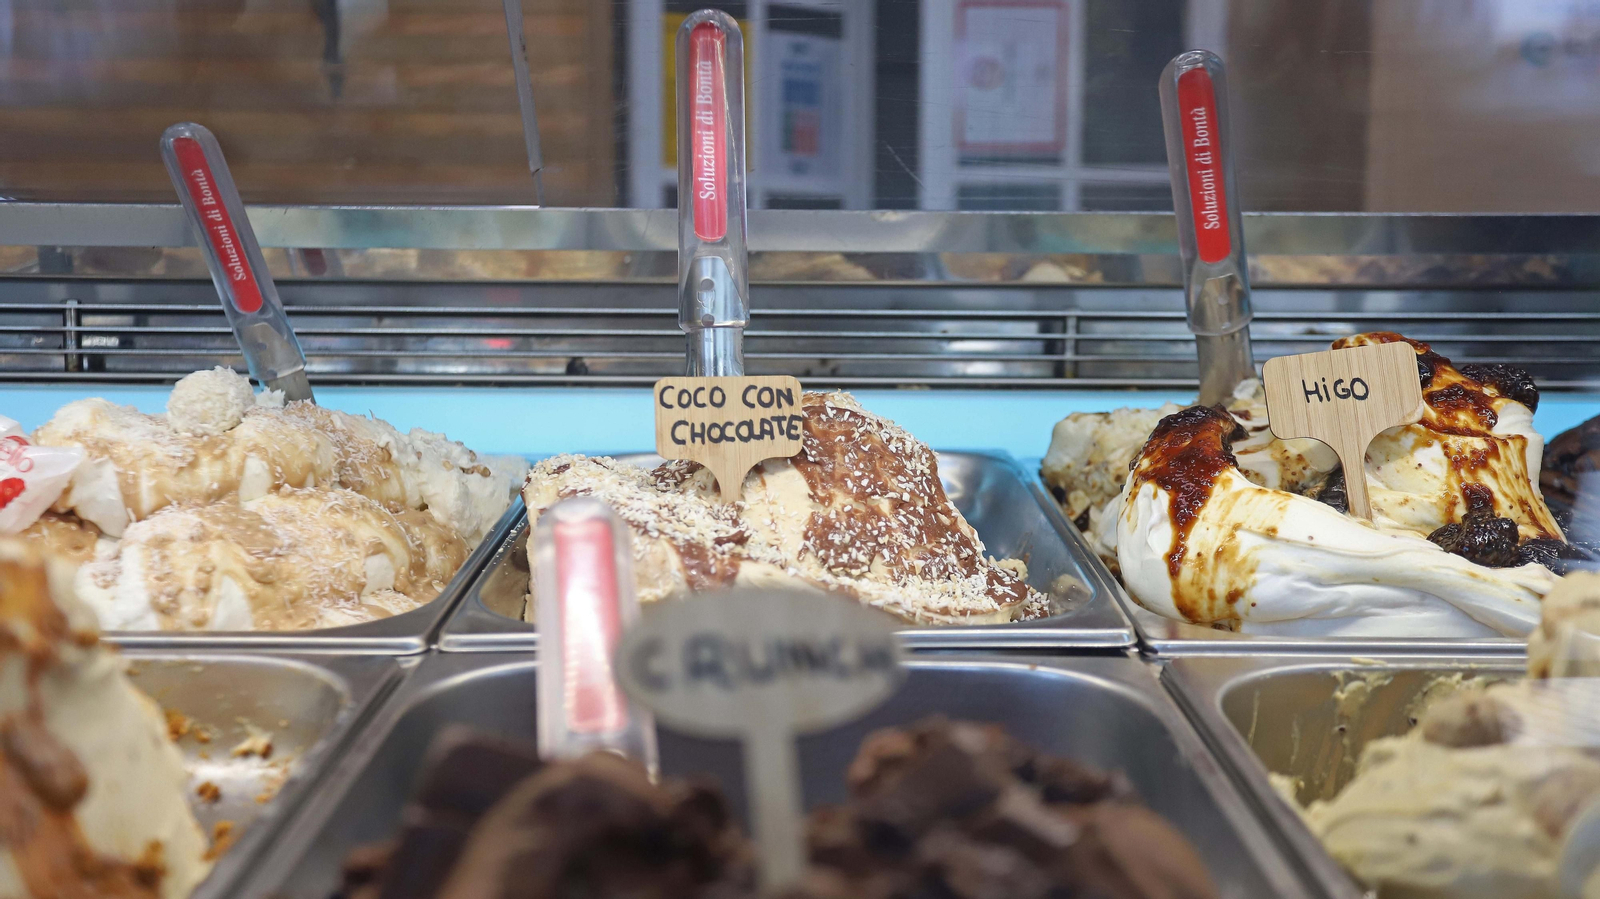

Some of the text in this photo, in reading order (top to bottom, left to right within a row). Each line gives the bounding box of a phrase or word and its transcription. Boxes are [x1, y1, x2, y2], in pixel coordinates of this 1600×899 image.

[695, 110, 714, 126] di
[697, 130, 716, 200] Soluzioni
[1190, 107, 1220, 230] Soluzioni di Bontà
[191, 168, 247, 281] Soluzioni di Bontà
[659, 384, 795, 409] COCO CON
[670, 414, 803, 445] CHOCOLATE
